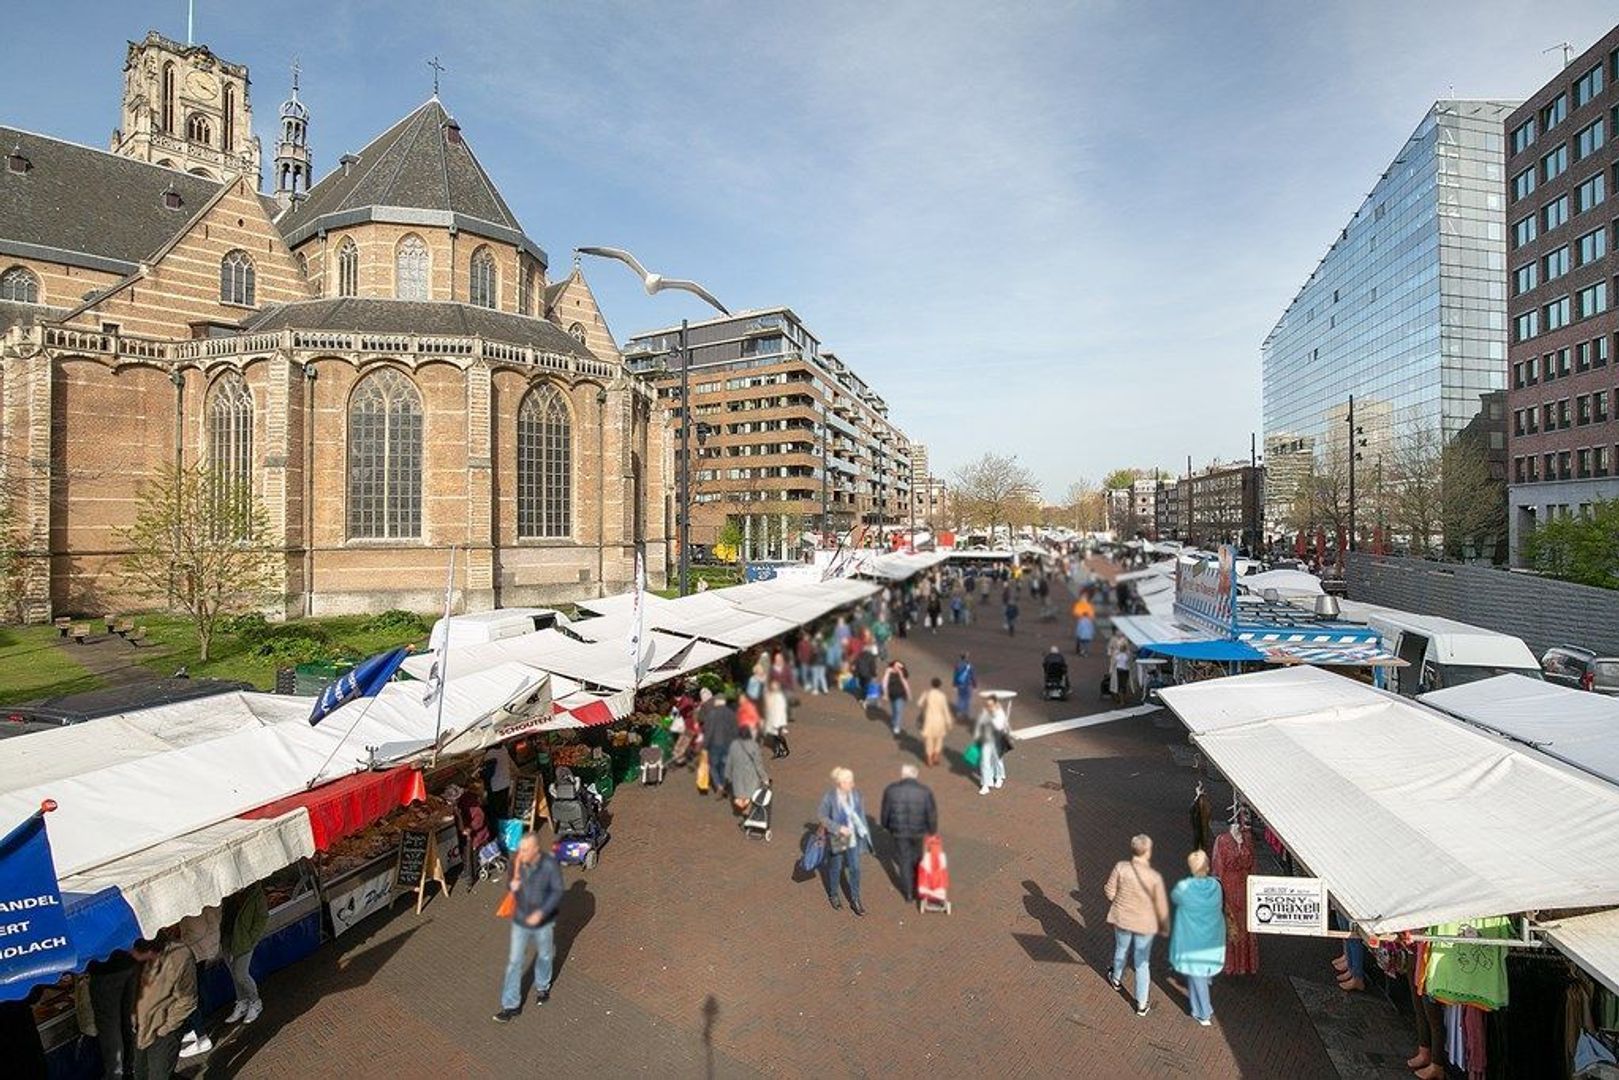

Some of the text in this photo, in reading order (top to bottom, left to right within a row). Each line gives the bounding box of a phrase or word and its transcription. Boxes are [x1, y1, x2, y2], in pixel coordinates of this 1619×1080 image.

[499, 714, 552, 737] SCHOUTEN
[1265, 896, 1307, 904] SONY
[1272, 902, 1320, 913] maxell
